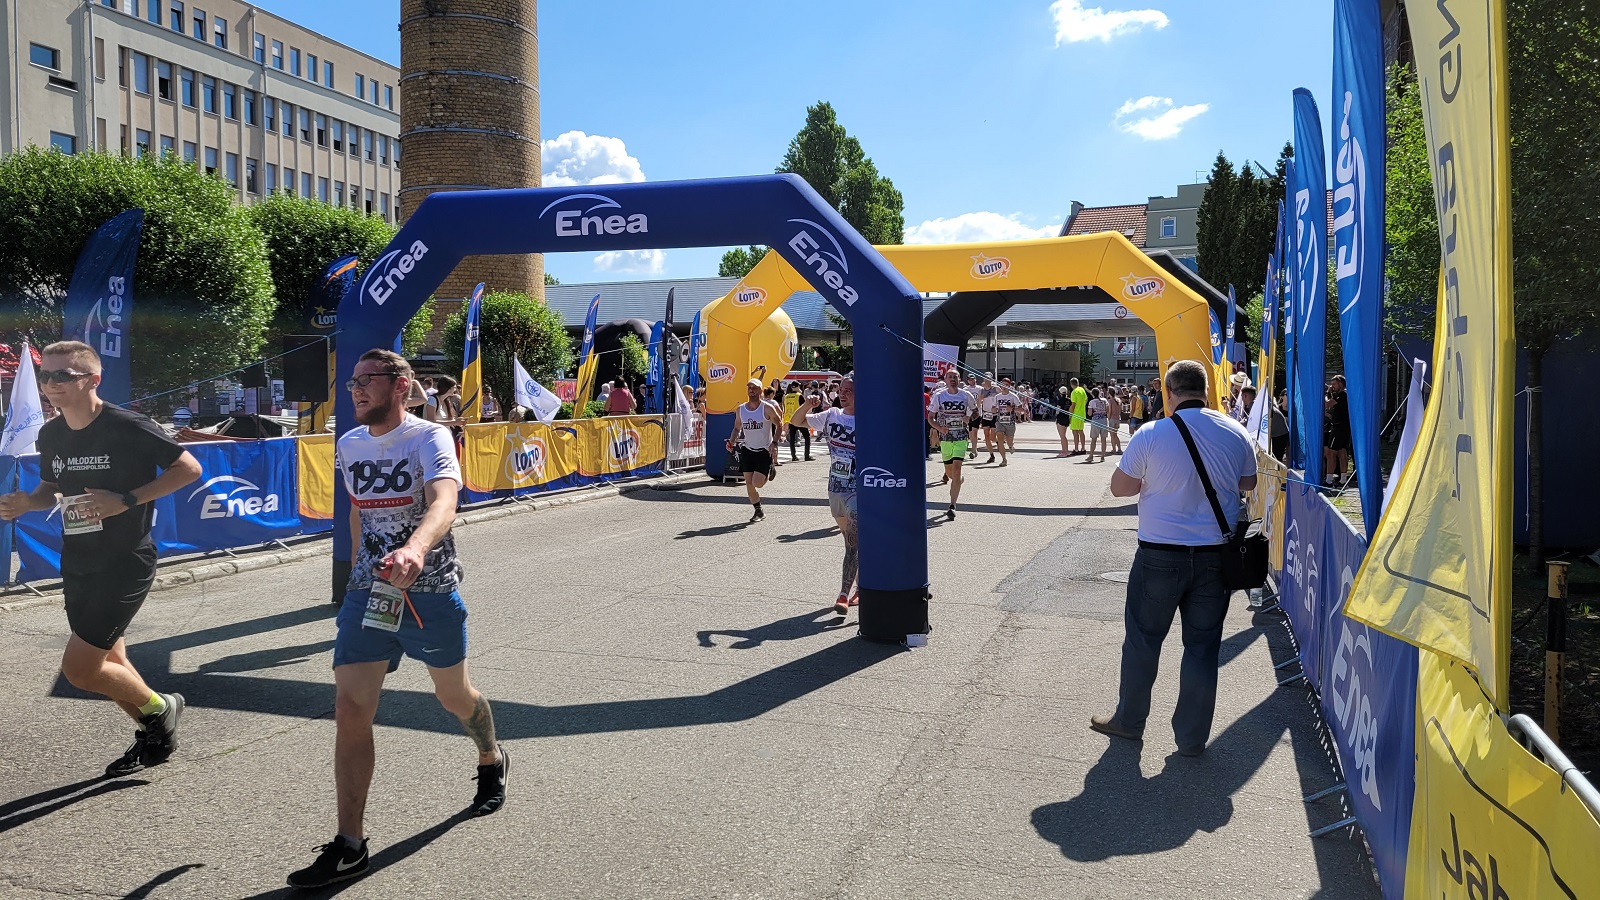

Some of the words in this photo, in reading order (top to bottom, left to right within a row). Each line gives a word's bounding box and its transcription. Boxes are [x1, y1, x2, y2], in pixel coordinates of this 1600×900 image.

[556, 210, 649, 236] Enea
[368, 239, 429, 305] Enea
[788, 230, 859, 307] Enea
[978, 260, 1002, 275] LOTTO
[738, 291, 760, 302] LOTTO
[1130, 281, 1156, 296] LOTTO
[100, 276, 126, 358] Enea
[318, 315, 337, 325] LOTT
[709, 367, 729, 378] LOTTO
[942, 401, 965, 410] 1956
[614, 437, 634, 458] LOTTO
[67, 454, 111, 465] MŁODZIEŻ
[514, 447, 540, 471] LOTTO
[348, 458, 413, 495] 1956
[863, 475, 907, 489] Enea
[200, 493, 279, 520] Enea
[1331, 620, 1382, 812] Enea
